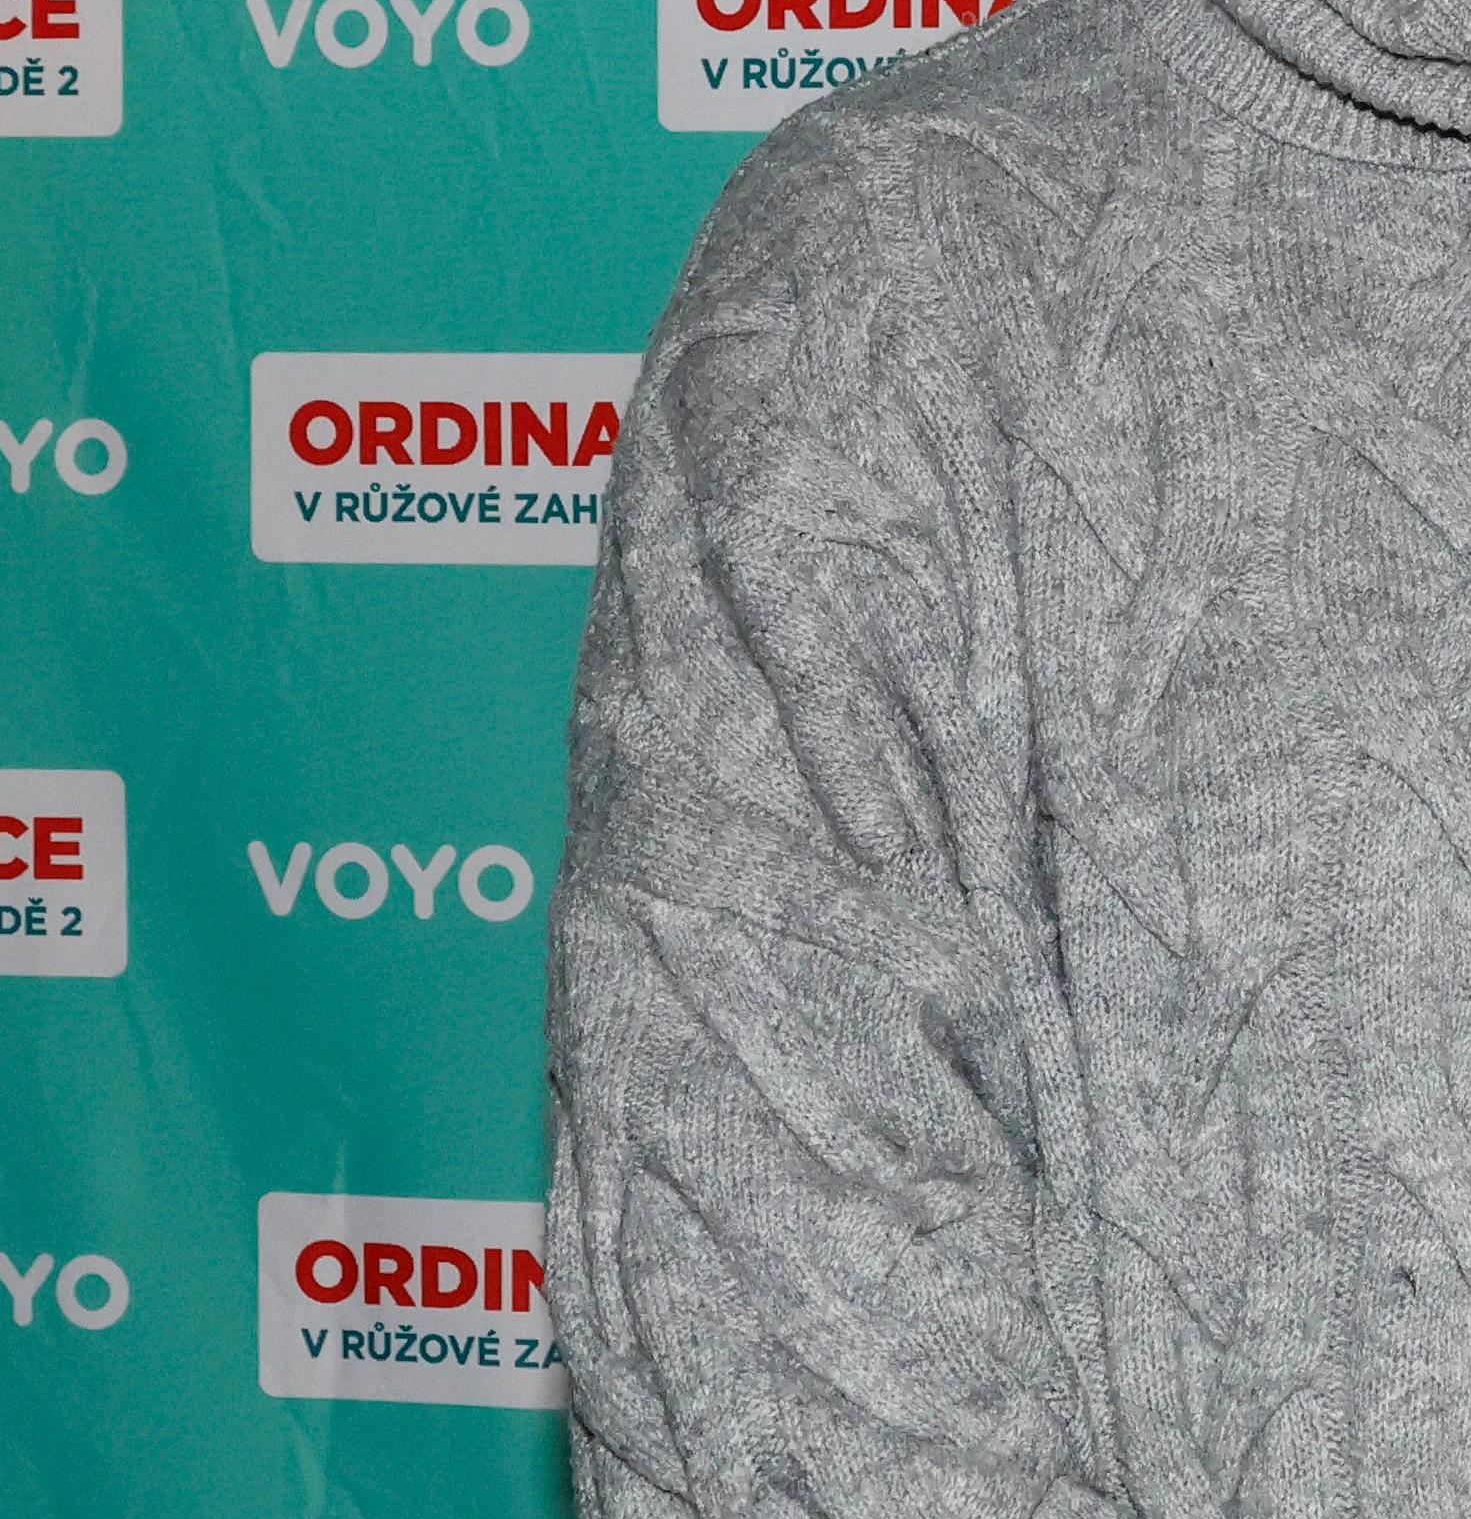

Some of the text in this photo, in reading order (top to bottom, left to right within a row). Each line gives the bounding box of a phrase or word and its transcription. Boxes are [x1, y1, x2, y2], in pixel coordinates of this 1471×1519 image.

[57, 64, 80, 97] 2
[248, 840, 534, 923] VOYO
[60, 904, 83, 938] 2
